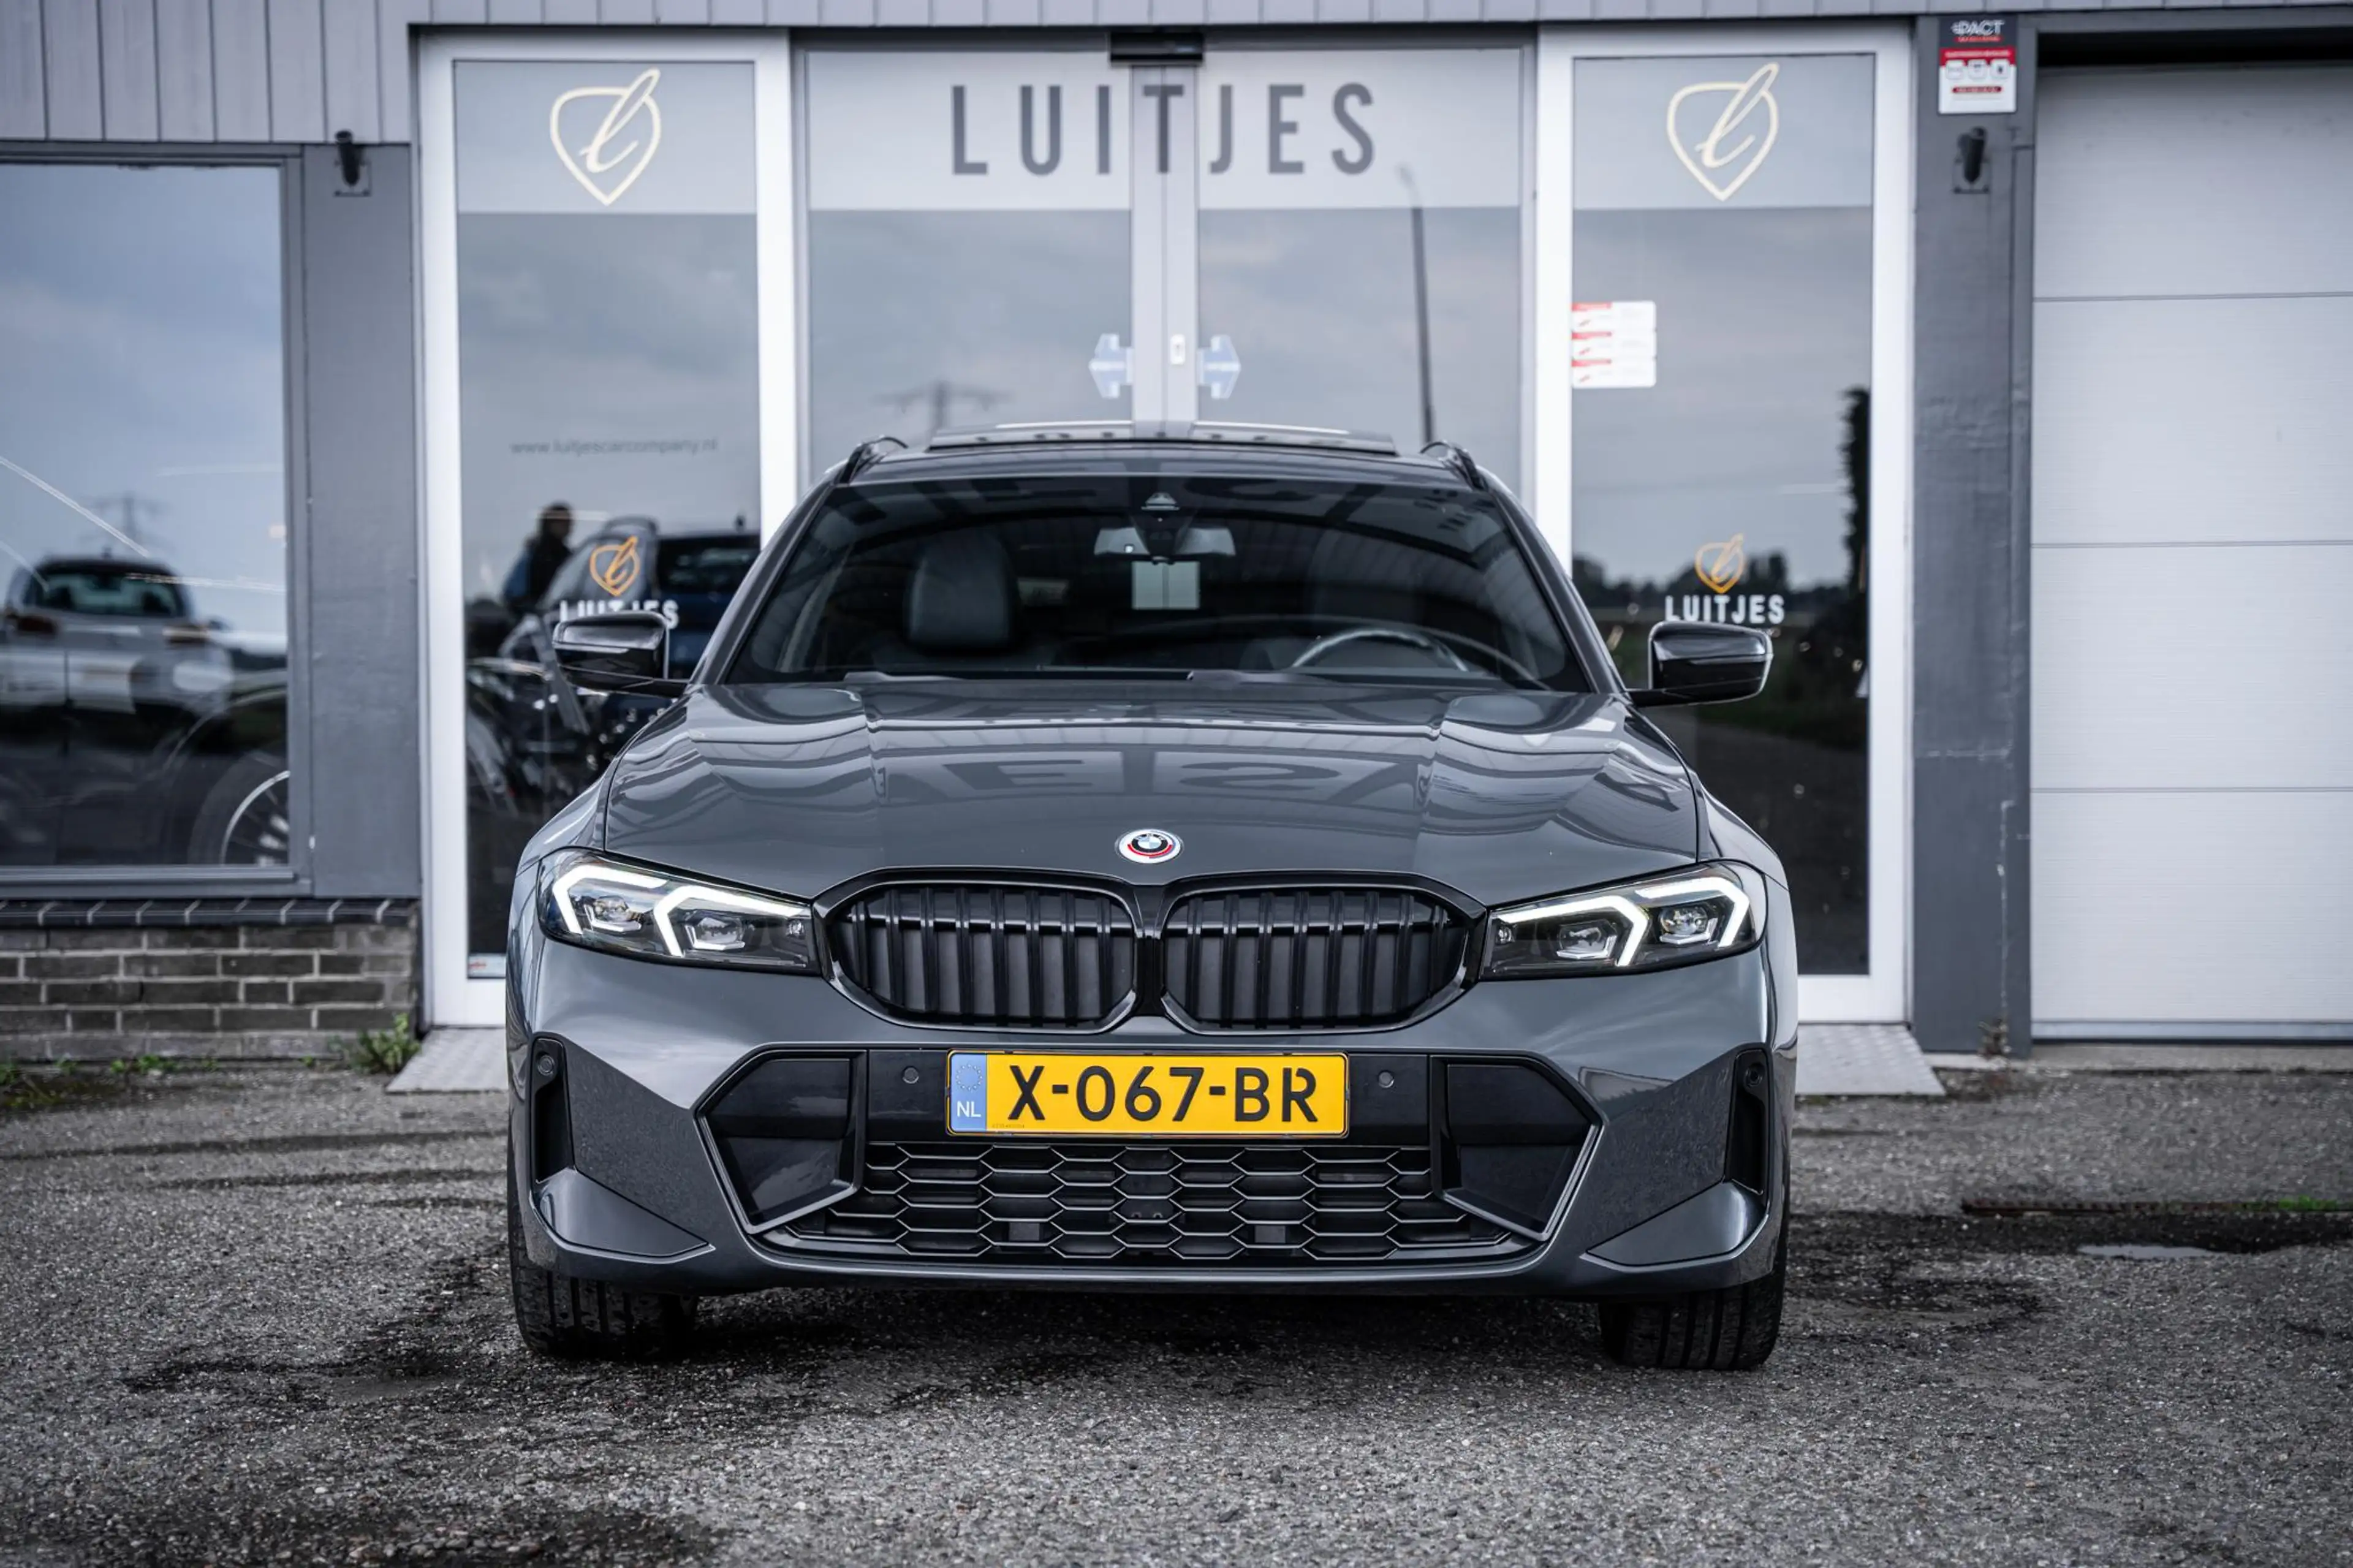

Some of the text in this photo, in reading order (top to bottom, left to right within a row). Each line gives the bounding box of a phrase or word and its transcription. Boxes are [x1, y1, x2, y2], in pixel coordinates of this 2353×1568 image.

[952, 83, 1374, 176] LUITJES
[1664, 594, 1786, 624] LUITJES
[957, 1065, 1318, 1123] NL X-067-BR
